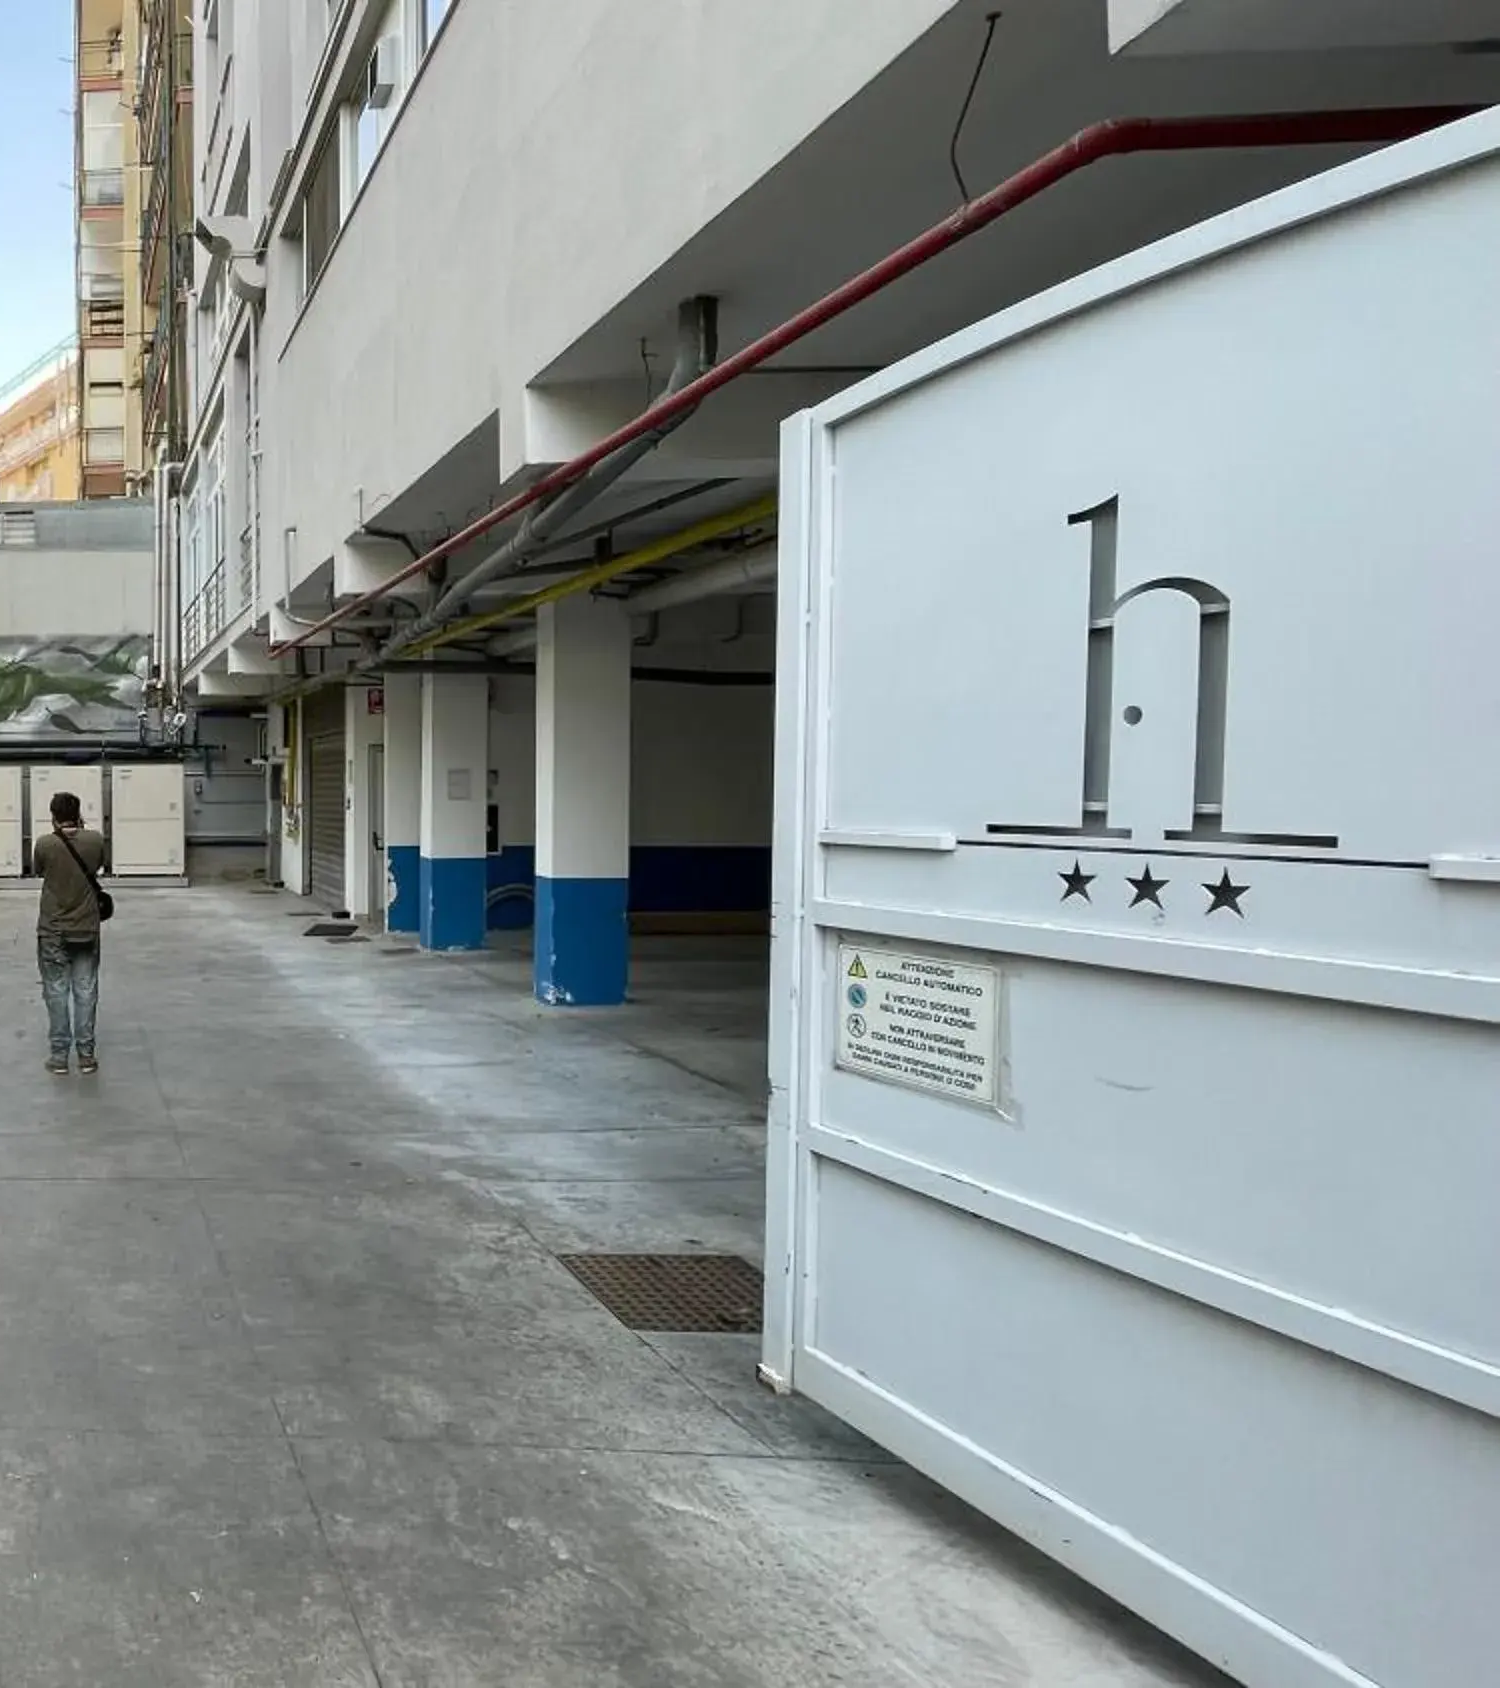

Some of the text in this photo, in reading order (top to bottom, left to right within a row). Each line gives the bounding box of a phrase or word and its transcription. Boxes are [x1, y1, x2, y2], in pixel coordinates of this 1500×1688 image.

[902, 962, 954, 978] ATTENZIONE
[876, 970, 983, 996] CANCELLO AUTOMATICO
[893, 994, 927, 1008] VIETATO
[930, 1002, 971, 1017] SOSTARE
[889, 1024, 904, 1034] NON
